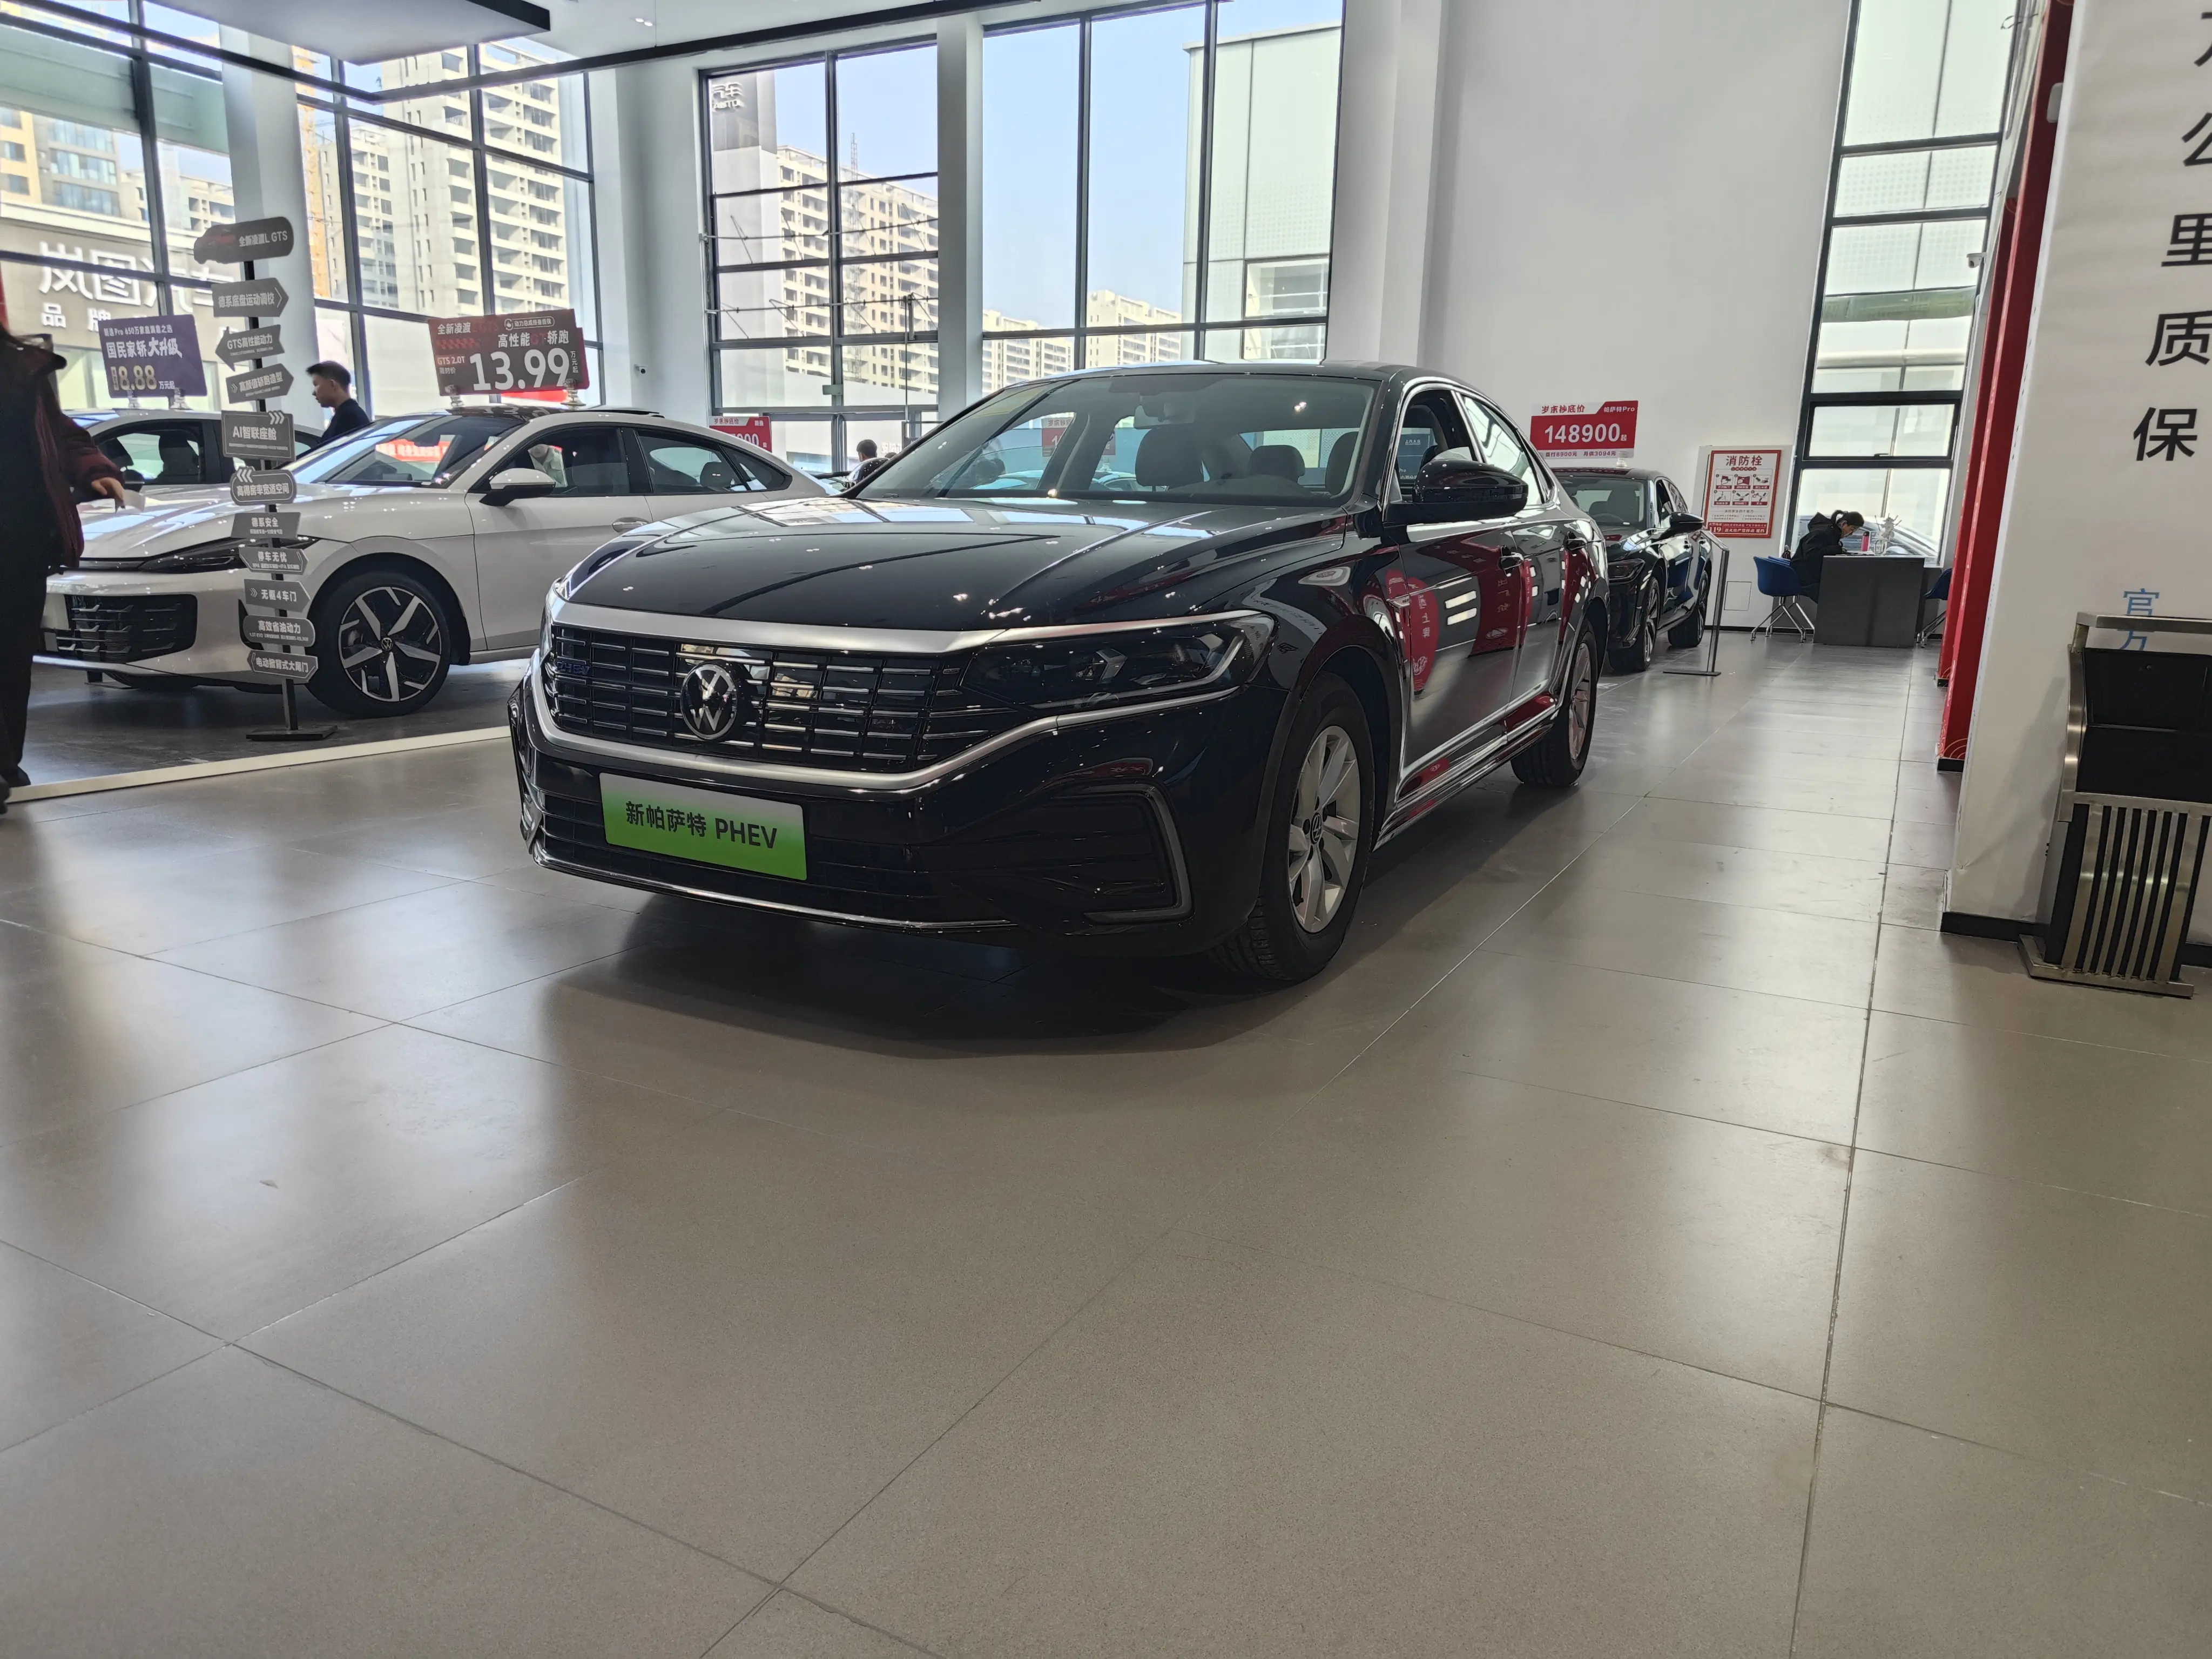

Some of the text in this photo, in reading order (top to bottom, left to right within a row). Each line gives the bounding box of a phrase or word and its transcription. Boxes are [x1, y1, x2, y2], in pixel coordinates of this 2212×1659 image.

[271, 231, 287, 242] GTS
[227, 333, 273, 350] GTS高性能动力
[437, 357, 450, 365] GTS
[470, 347, 570, 392] 13.99
[232, 426, 277, 441] AI智联座舱
[1545, 423, 1620, 443] 148900
[1726, 455, 1763, 467] 消防栓
[258, 551, 287, 563] 停车无忧
[261, 589, 297, 602] 无框4车门
[258, 620, 301, 634] 高效省油动力
[625, 800, 778, 849] 新帕萨特 PHEV
